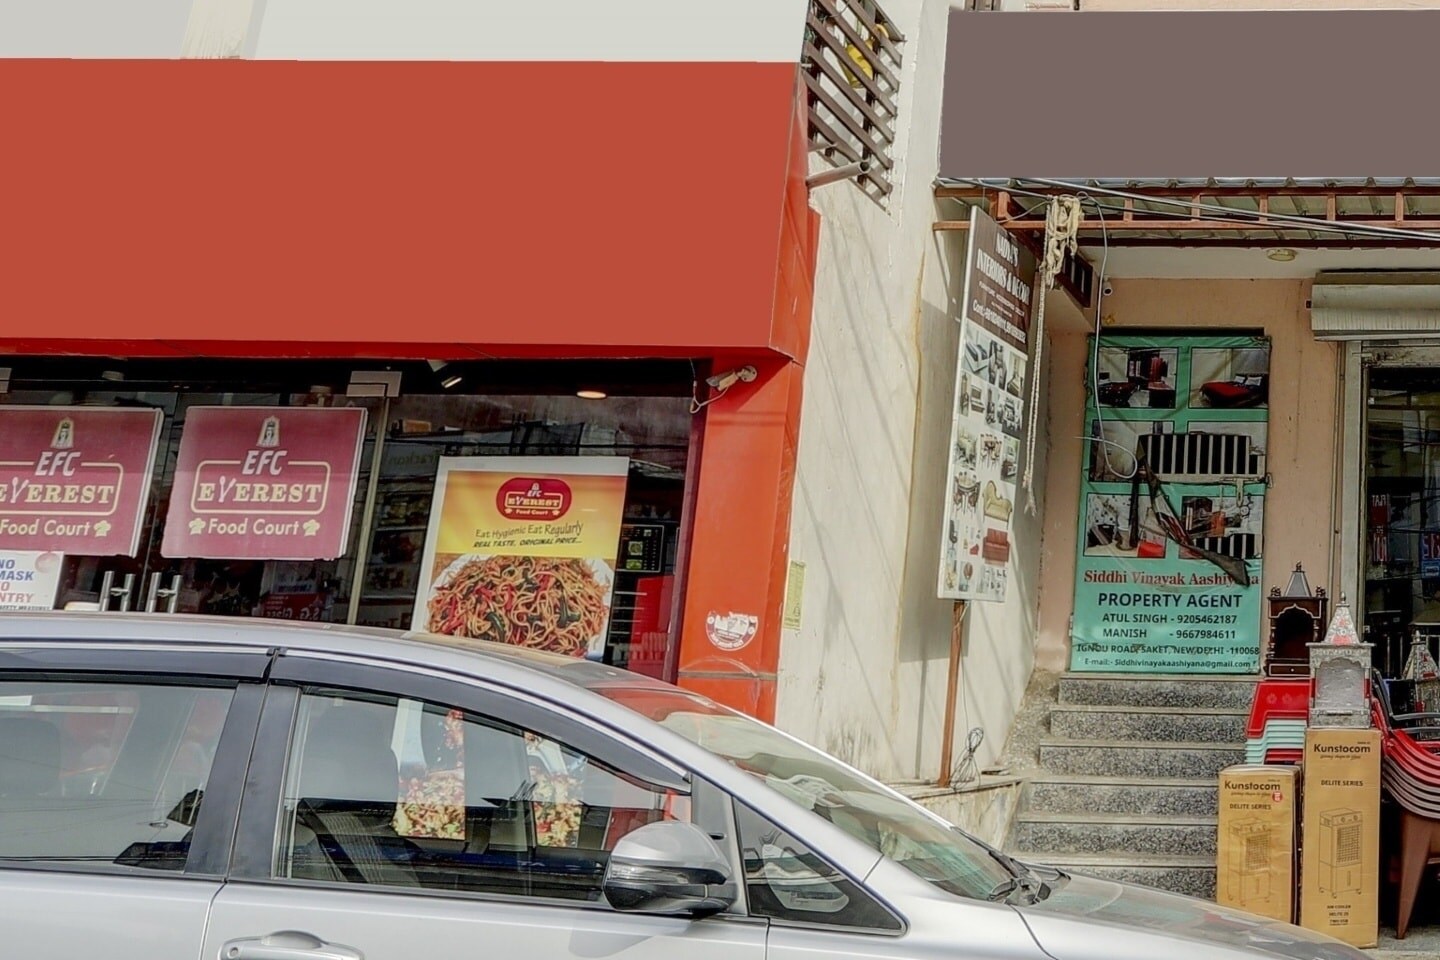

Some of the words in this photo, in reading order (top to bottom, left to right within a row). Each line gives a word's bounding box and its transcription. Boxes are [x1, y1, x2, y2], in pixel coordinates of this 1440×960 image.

[977, 248, 1007, 289] INTERIORS
[34, 451, 81, 476] EFC
[242, 450, 288, 475] EFC
[197, 476, 322, 503] EVEREST
[507, 496, 560, 507] EVEREST
[0, 519, 39, 535] Food
[43, 520, 90, 536] Court
[208, 518, 248, 535] Food
[253, 519, 299, 535] Court
[475, 529, 490, 538] Eat
[492, 525, 526, 540] Hygienic
[528, 525, 542, 534] Eat
[545, 520, 583, 536] Regularly
[1084, 569, 1127, 583] Siddhi
[1131, 571, 1184, 588] Vinayak
[1189, 573, 1259, 587] Aashiya
[0, 593, 34, 603] NTRY
[1098, 593, 1182, 607] PROPERTY
[1186, 594, 1243, 608] AGENT
[1102, 613, 1130, 622] ATUL
[1132, 613, 1167, 624] SINGH
[1177, 614, 1237, 624] 9205462187
[1103, 628, 1147, 638] MANISH
[1176, 630, 1236, 639] 9667984611
[1173, 646, 1194, 654] NEW
[1314, 743, 1370, 753] Kunstocom
[1224, 781, 1281, 791] Kunstocom
